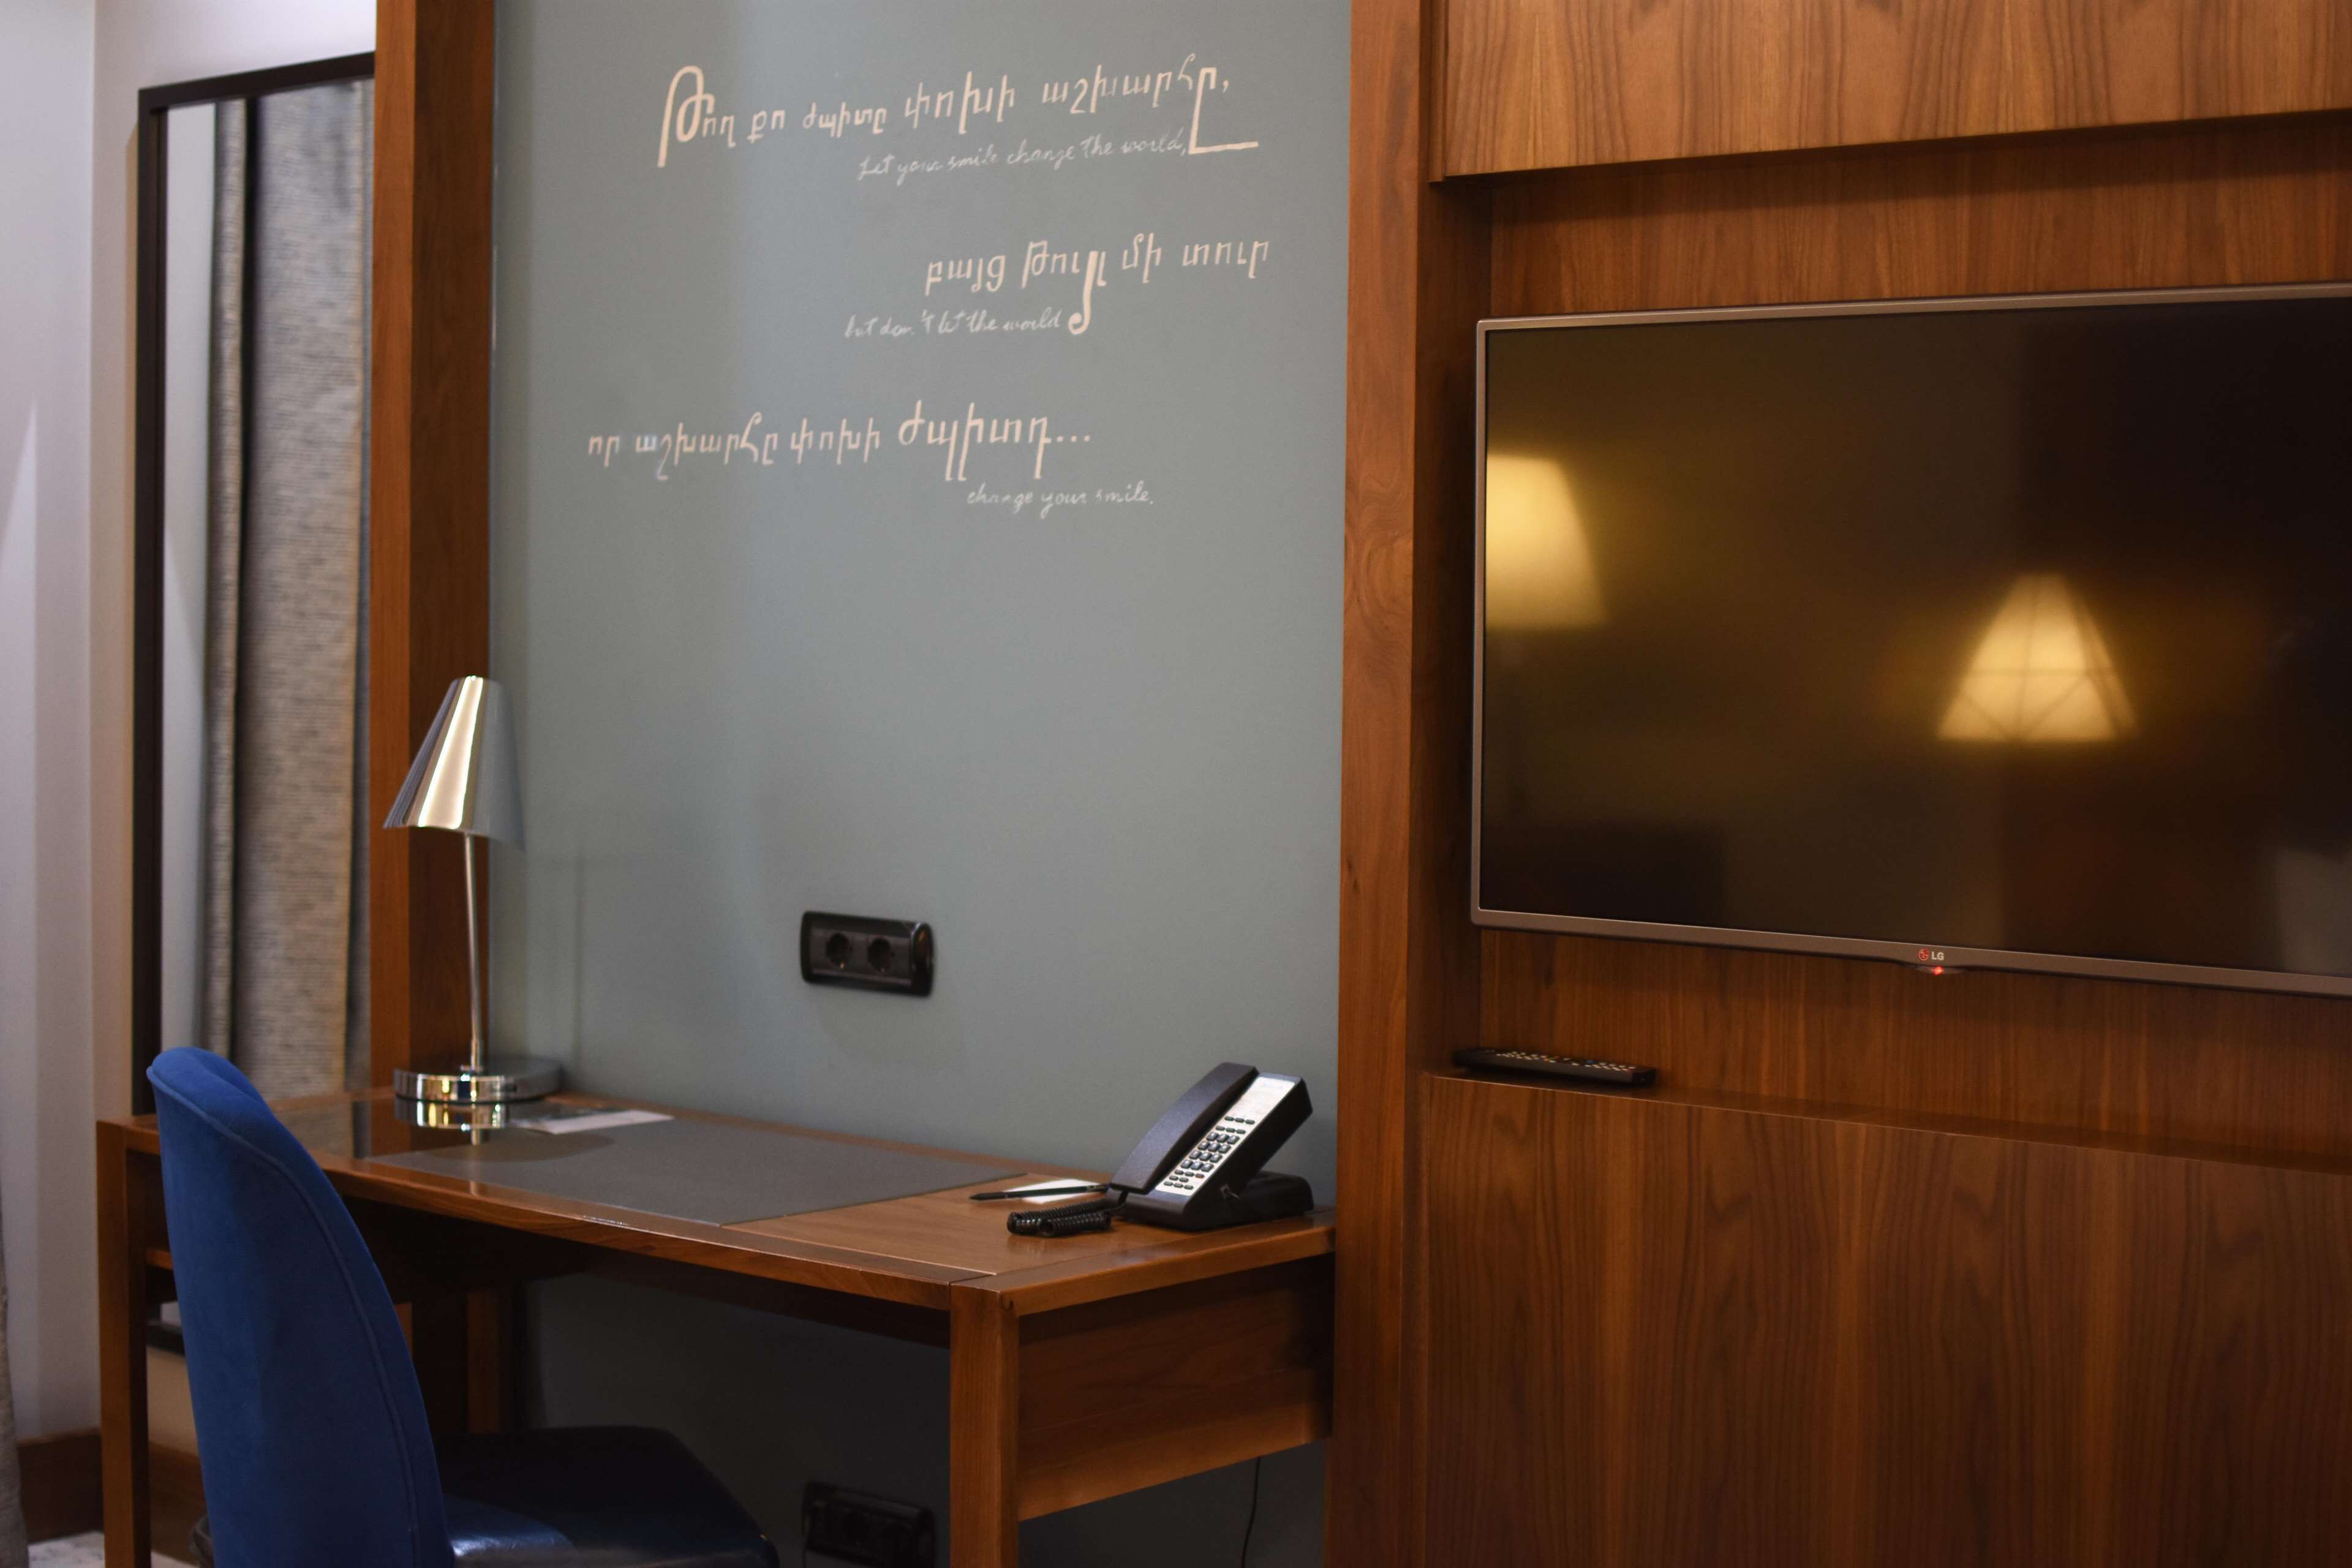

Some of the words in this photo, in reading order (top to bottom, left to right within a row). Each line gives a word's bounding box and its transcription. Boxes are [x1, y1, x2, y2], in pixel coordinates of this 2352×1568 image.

[657, 64, 737, 168] Թող
[747, 109, 785, 144] քո
[802, 102, 887, 138] ժպիտը
[904, 74, 1015, 135] փոխի
[1042, 53, 1260, 156] աշխարհը,
[897, 159, 943, 186] your
[946, 143, 998, 171] smile
[1006, 138, 1075, 170] change
[924, 255, 1007, 296] բայց
[1121, 232, 1163, 285] մի
[1182, 241, 1269, 280] տուր
[845, 314, 879, 338] but
[938, 311, 966, 334] let
[966, 309, 998, 333] the
[1002, 306, 1062, 331] world
[588, 435, 620, 468] որ
[635, 412, 778, 481] աշխարհը
[790, 417, 881, 466] փոխի
[967, 482, 1033, 514] change
[1040, 492, 1087, 520] your
[1931, 951, 1945, 961] LG
